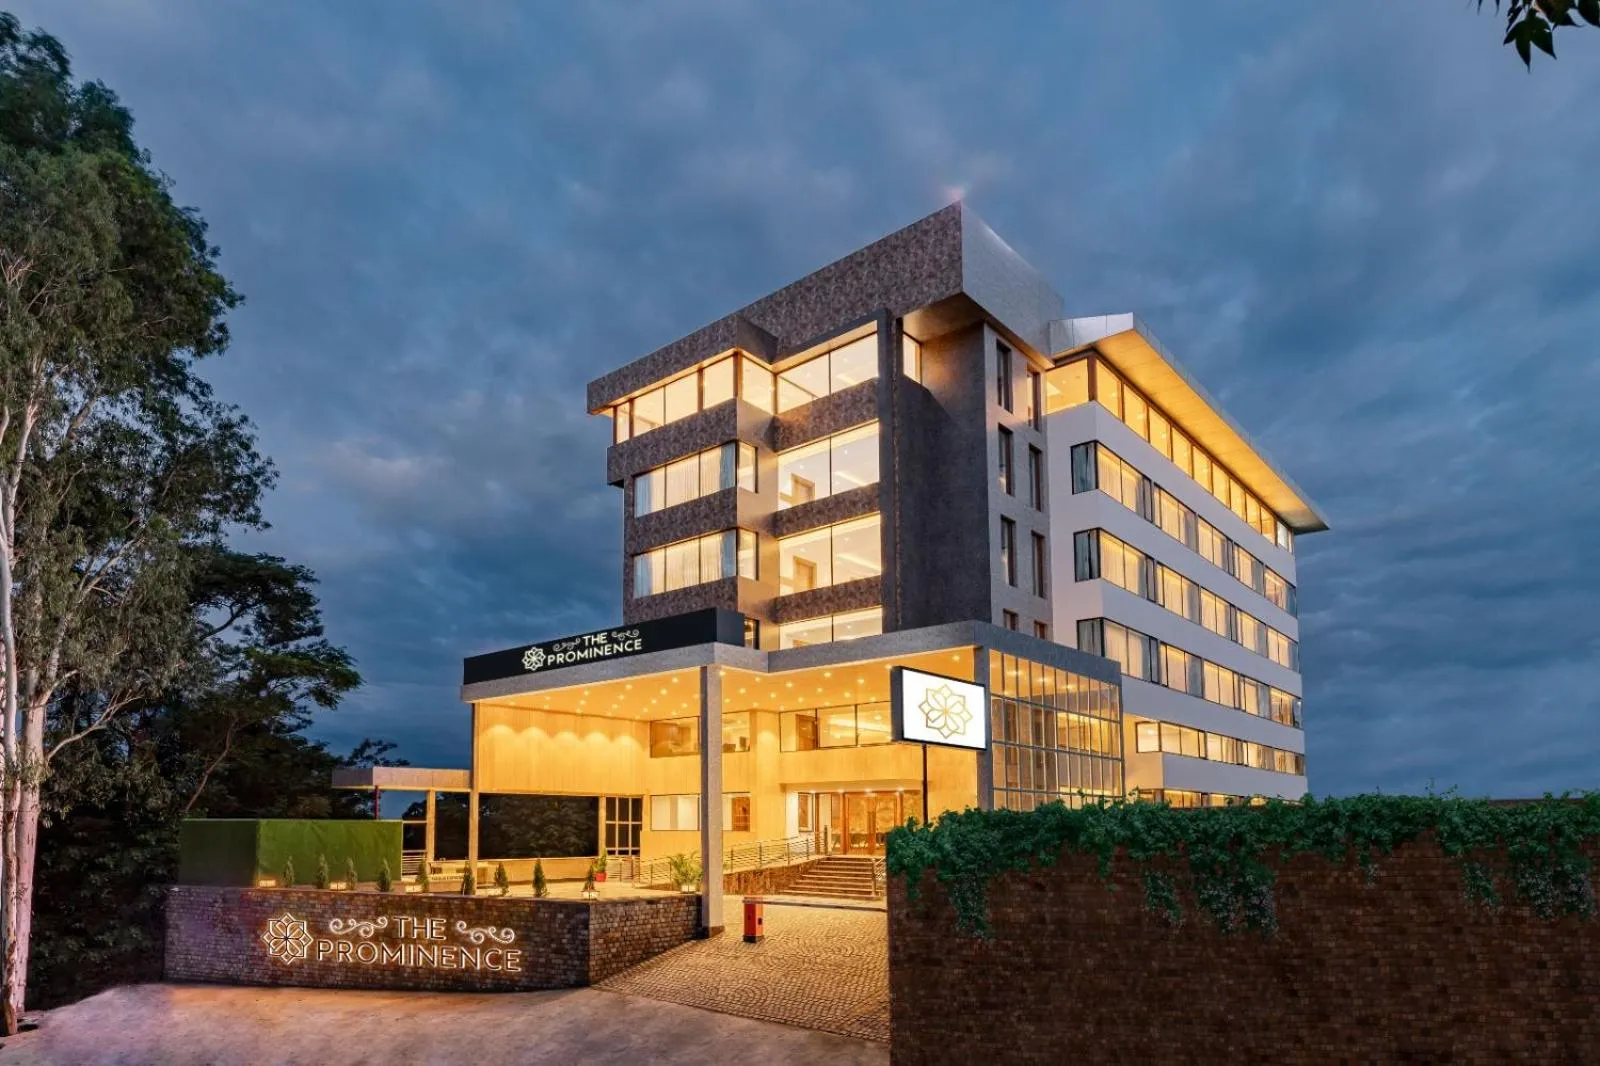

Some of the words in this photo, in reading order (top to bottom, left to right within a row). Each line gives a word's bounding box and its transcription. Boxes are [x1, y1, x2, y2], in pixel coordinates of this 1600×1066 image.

[583, 632, 608, 646] THE
[547, 639, 642, 666] PROMINENCE
[393, 916, 447, 940] THE
[316, 939, 522, 972] PROMINENCE
